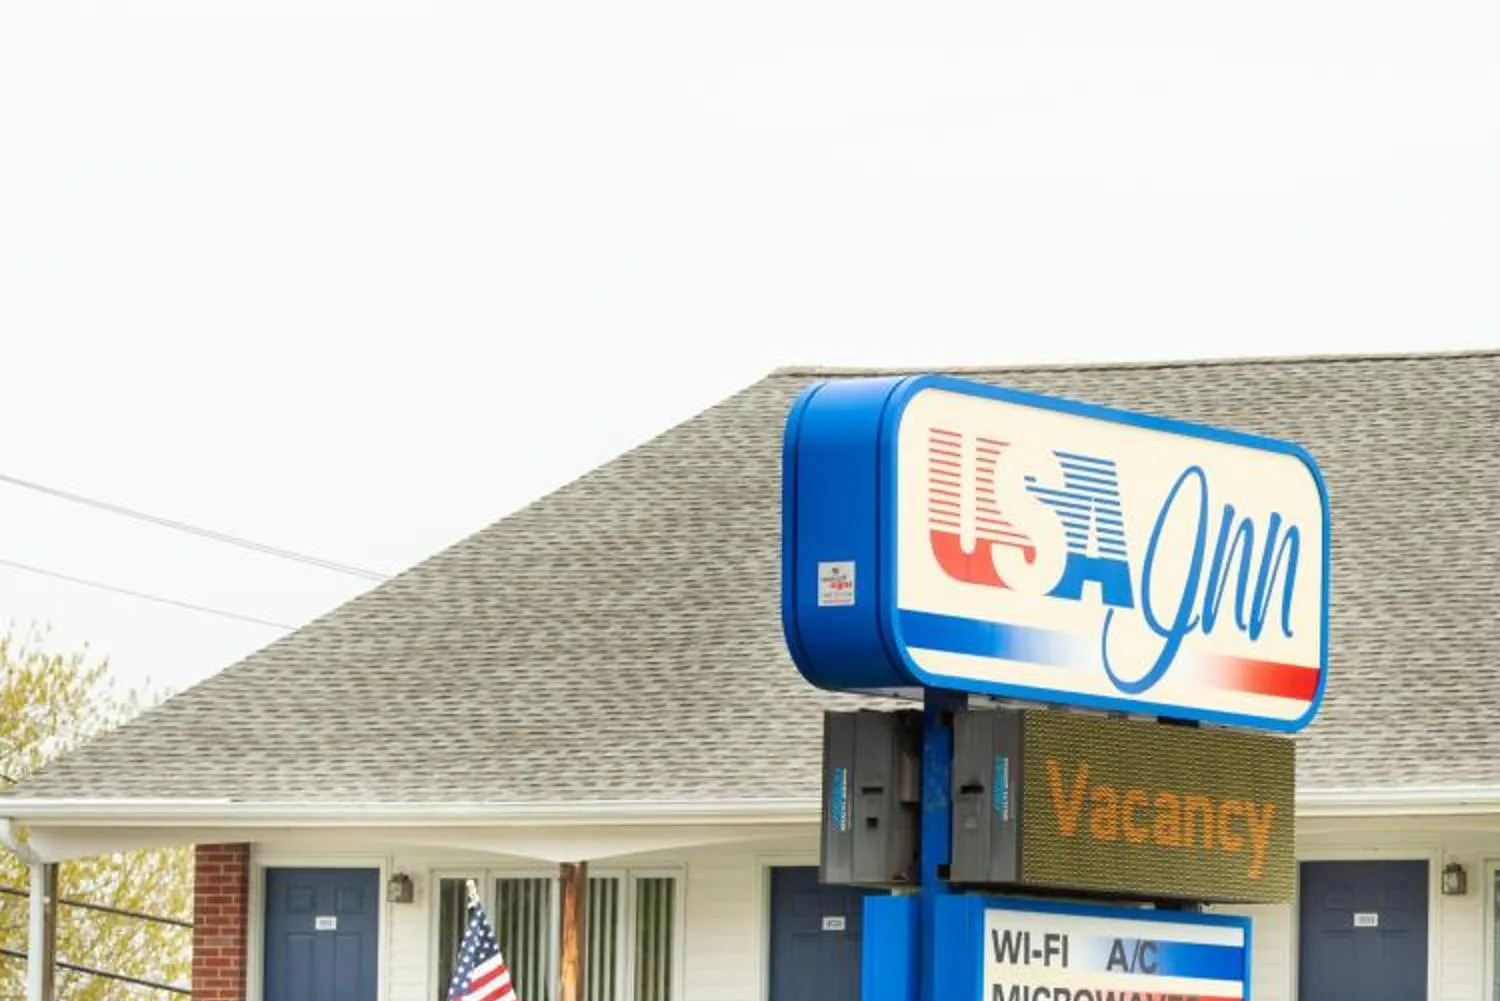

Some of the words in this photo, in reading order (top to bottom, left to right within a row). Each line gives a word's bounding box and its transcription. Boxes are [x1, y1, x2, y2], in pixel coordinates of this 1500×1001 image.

[929, 427, 1135, 609] USA
[1102, 465, 1301, 694] Inn
[1045, 754, 1277, 881] Vacancy
[992, 929, 1069, 969] WI-FI
[1106, 938, 1158, 974] A/C
